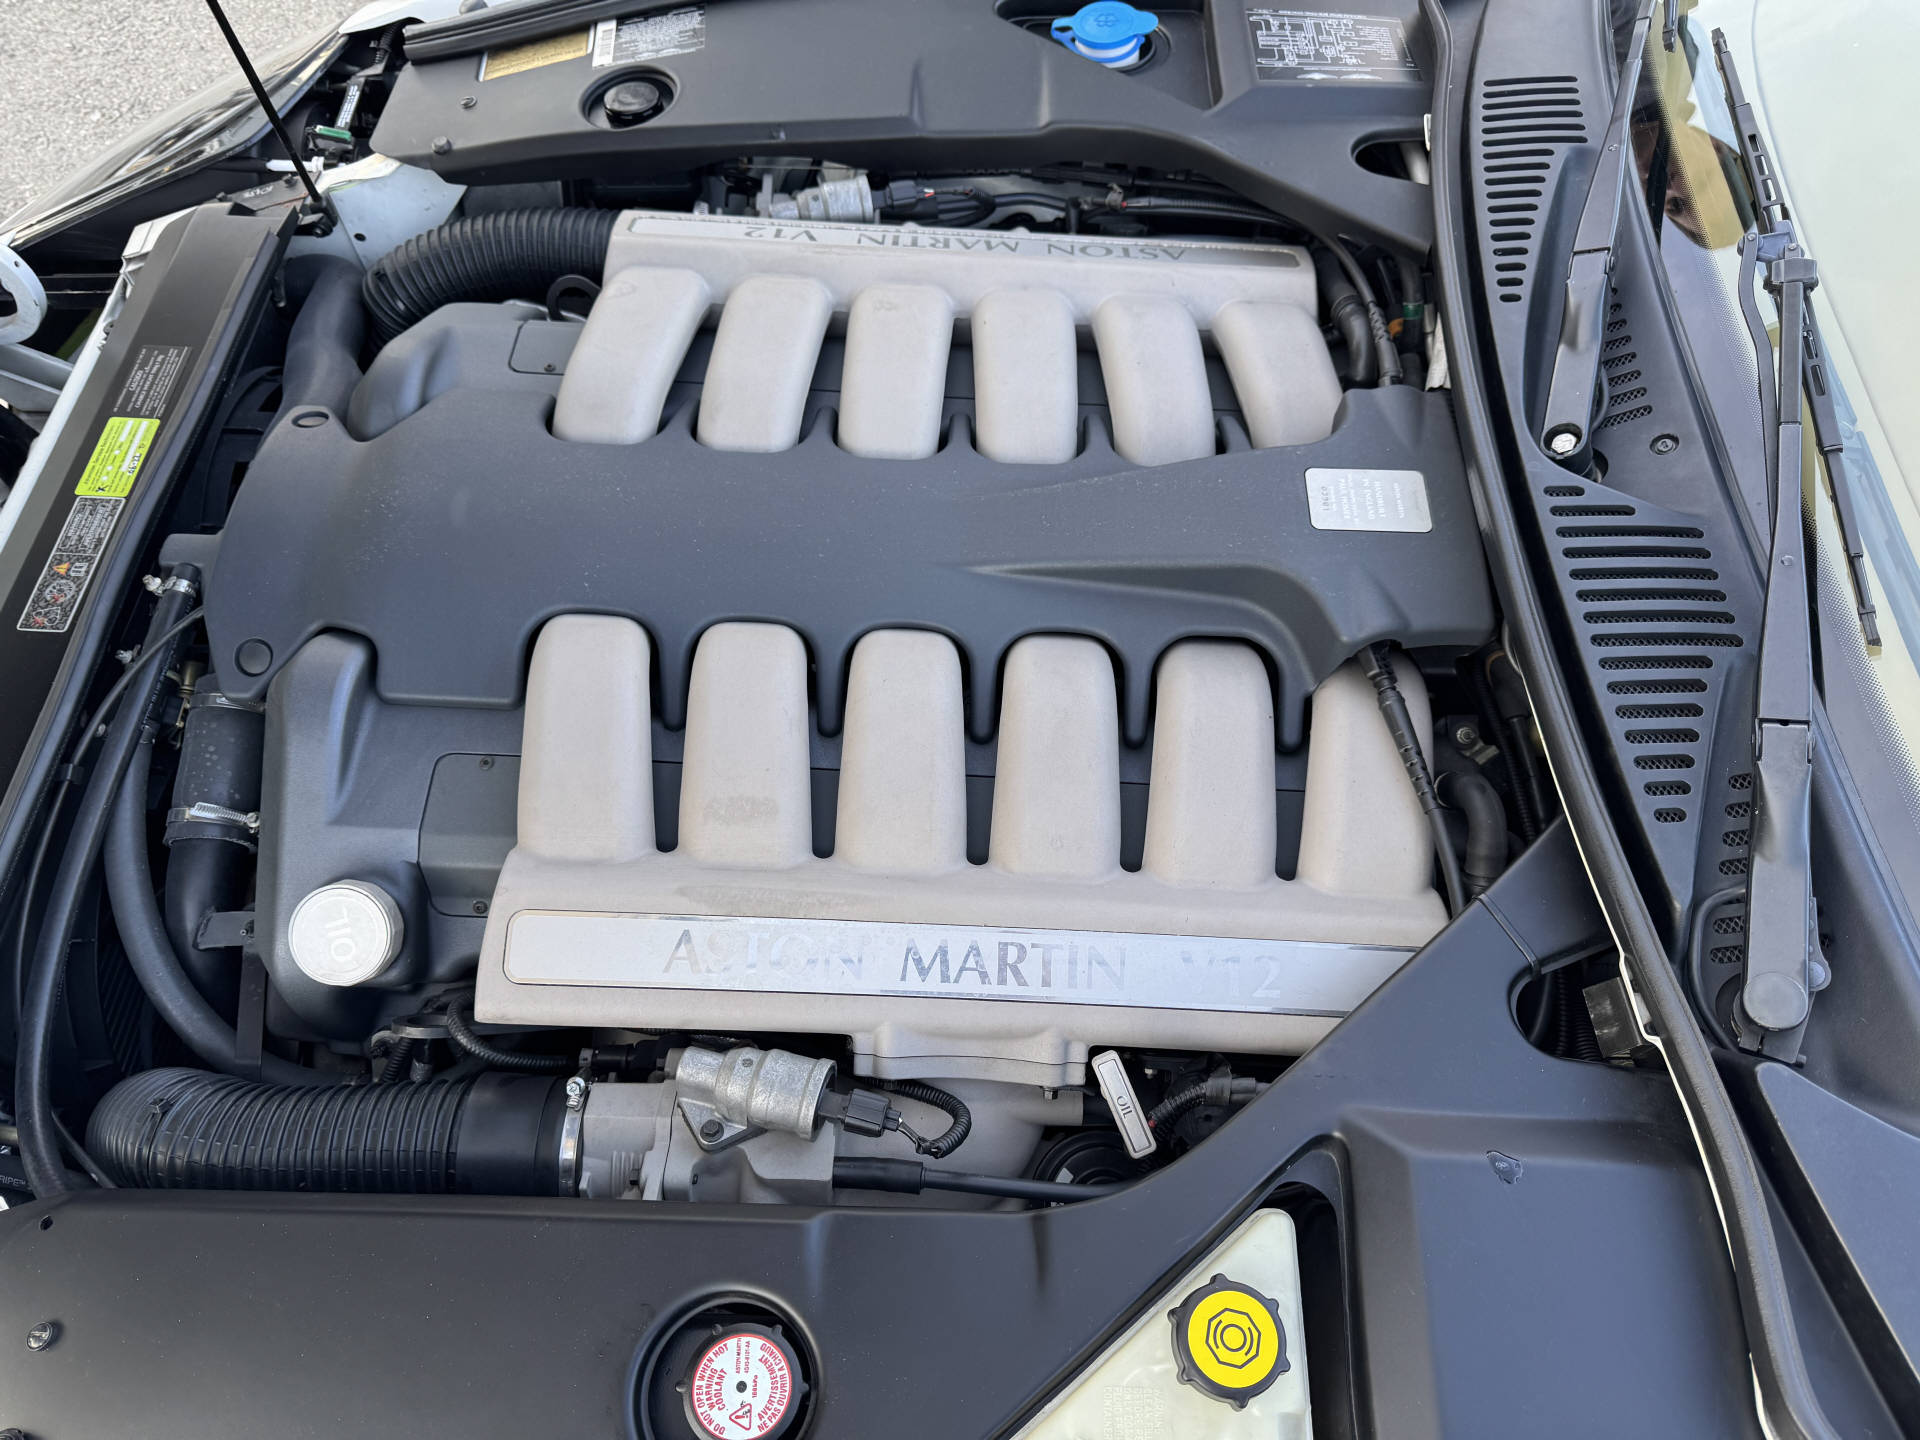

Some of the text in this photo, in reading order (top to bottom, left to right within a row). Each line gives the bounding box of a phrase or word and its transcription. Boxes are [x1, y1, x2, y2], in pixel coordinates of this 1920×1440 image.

[743, 225, 1188, 261] ASTON MARTIN V12
[325, 905, 356, 962] OIL
[899, 937, 1127, 990] MARTIN
[1116, 1095, 1133, 1119] OIL
[760, 1343, 783, 1367] CHAUD
[695, 1343, 729, 1436] DO NOT OPEN WHEN HOT
[704, 1367, 719, 1412] WARNING
[713, 1368, 728, 1412] COOLANT
[757, 1354, 779, 1421] AVERTISSEMENT
[776, 1373, 788, 1407] OUVRIR
[757, 1422, 769, 1433] NE
[767, 1406, 781, 1423] PAS
